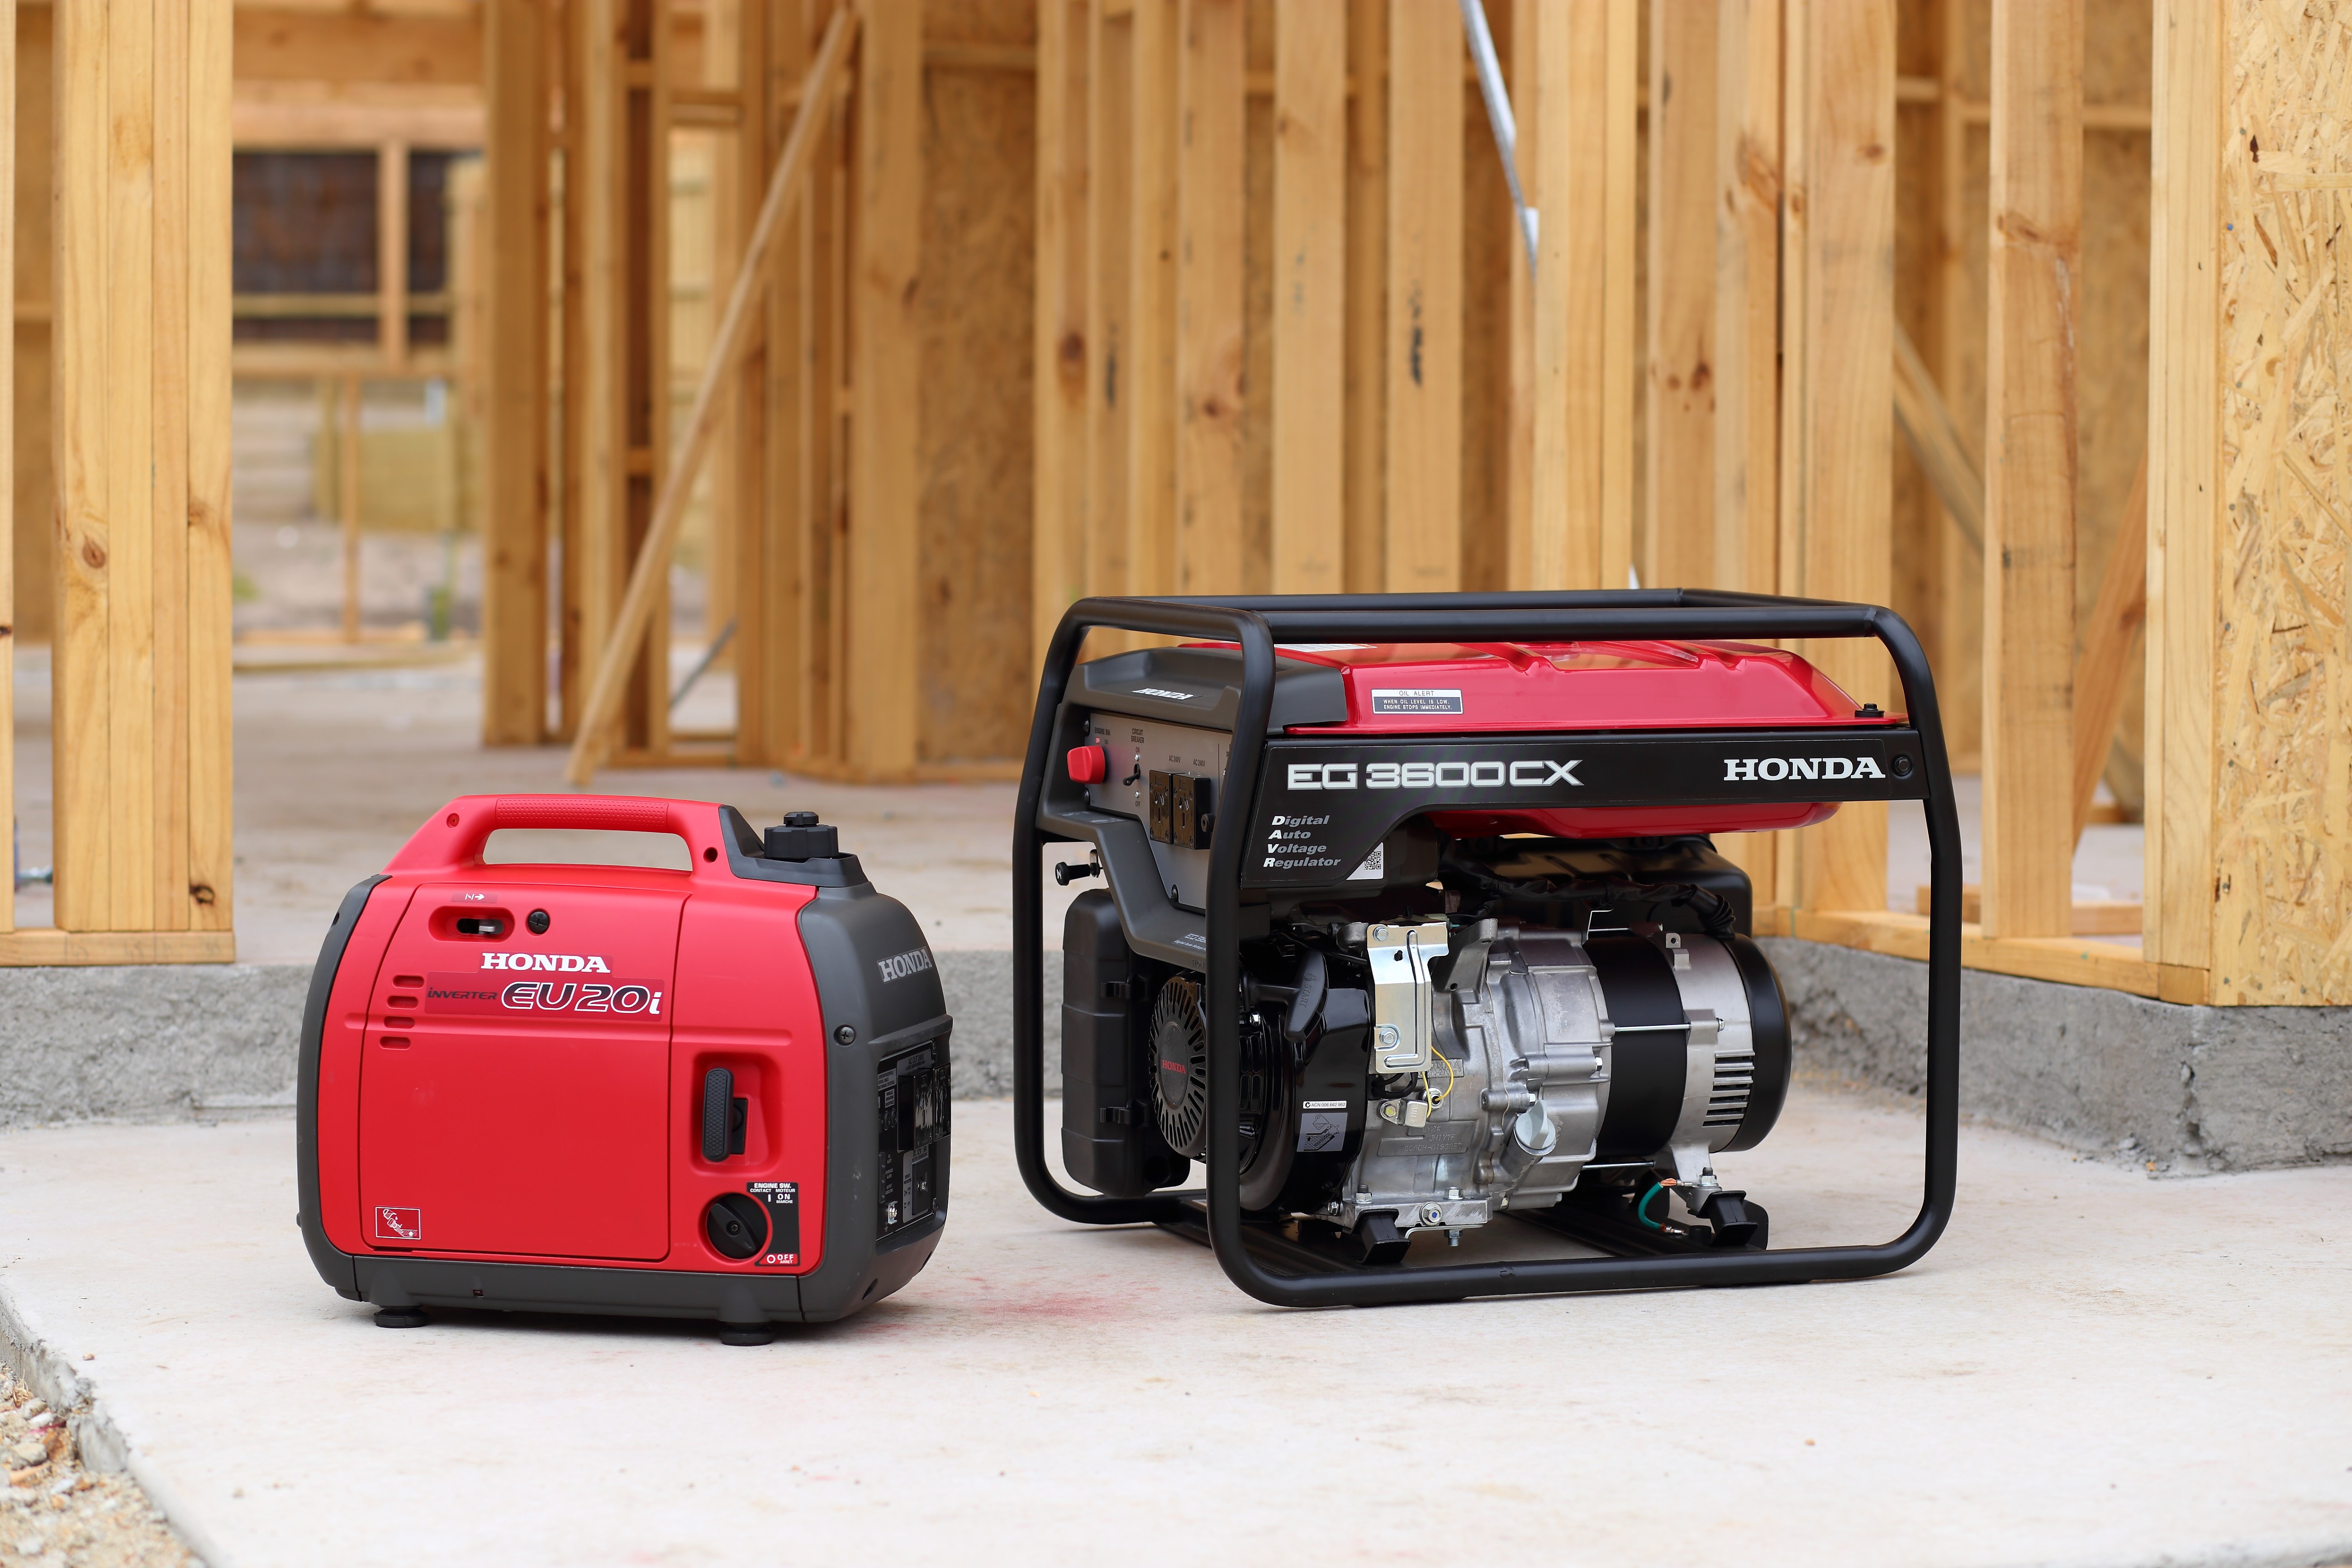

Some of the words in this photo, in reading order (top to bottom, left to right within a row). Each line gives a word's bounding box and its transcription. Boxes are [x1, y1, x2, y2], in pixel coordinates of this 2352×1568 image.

[1132, 688, 1193, 700] HONDA
[1724, 757, 1886, 781] HONDA
[1272, 815, 1330, 827] Digital
[1268, 830, 1311, 839] Auto
[1268, 844, 1327, 855] Voltage
[1264, 857, 1341, 869] Regulator
[481, 952, 610, 973] HONDA
[878, 949, 932, 982] HONDA
[1300, 984, 1311, 1007] START
[1162, 1059, 1186, 1074] HONDA
